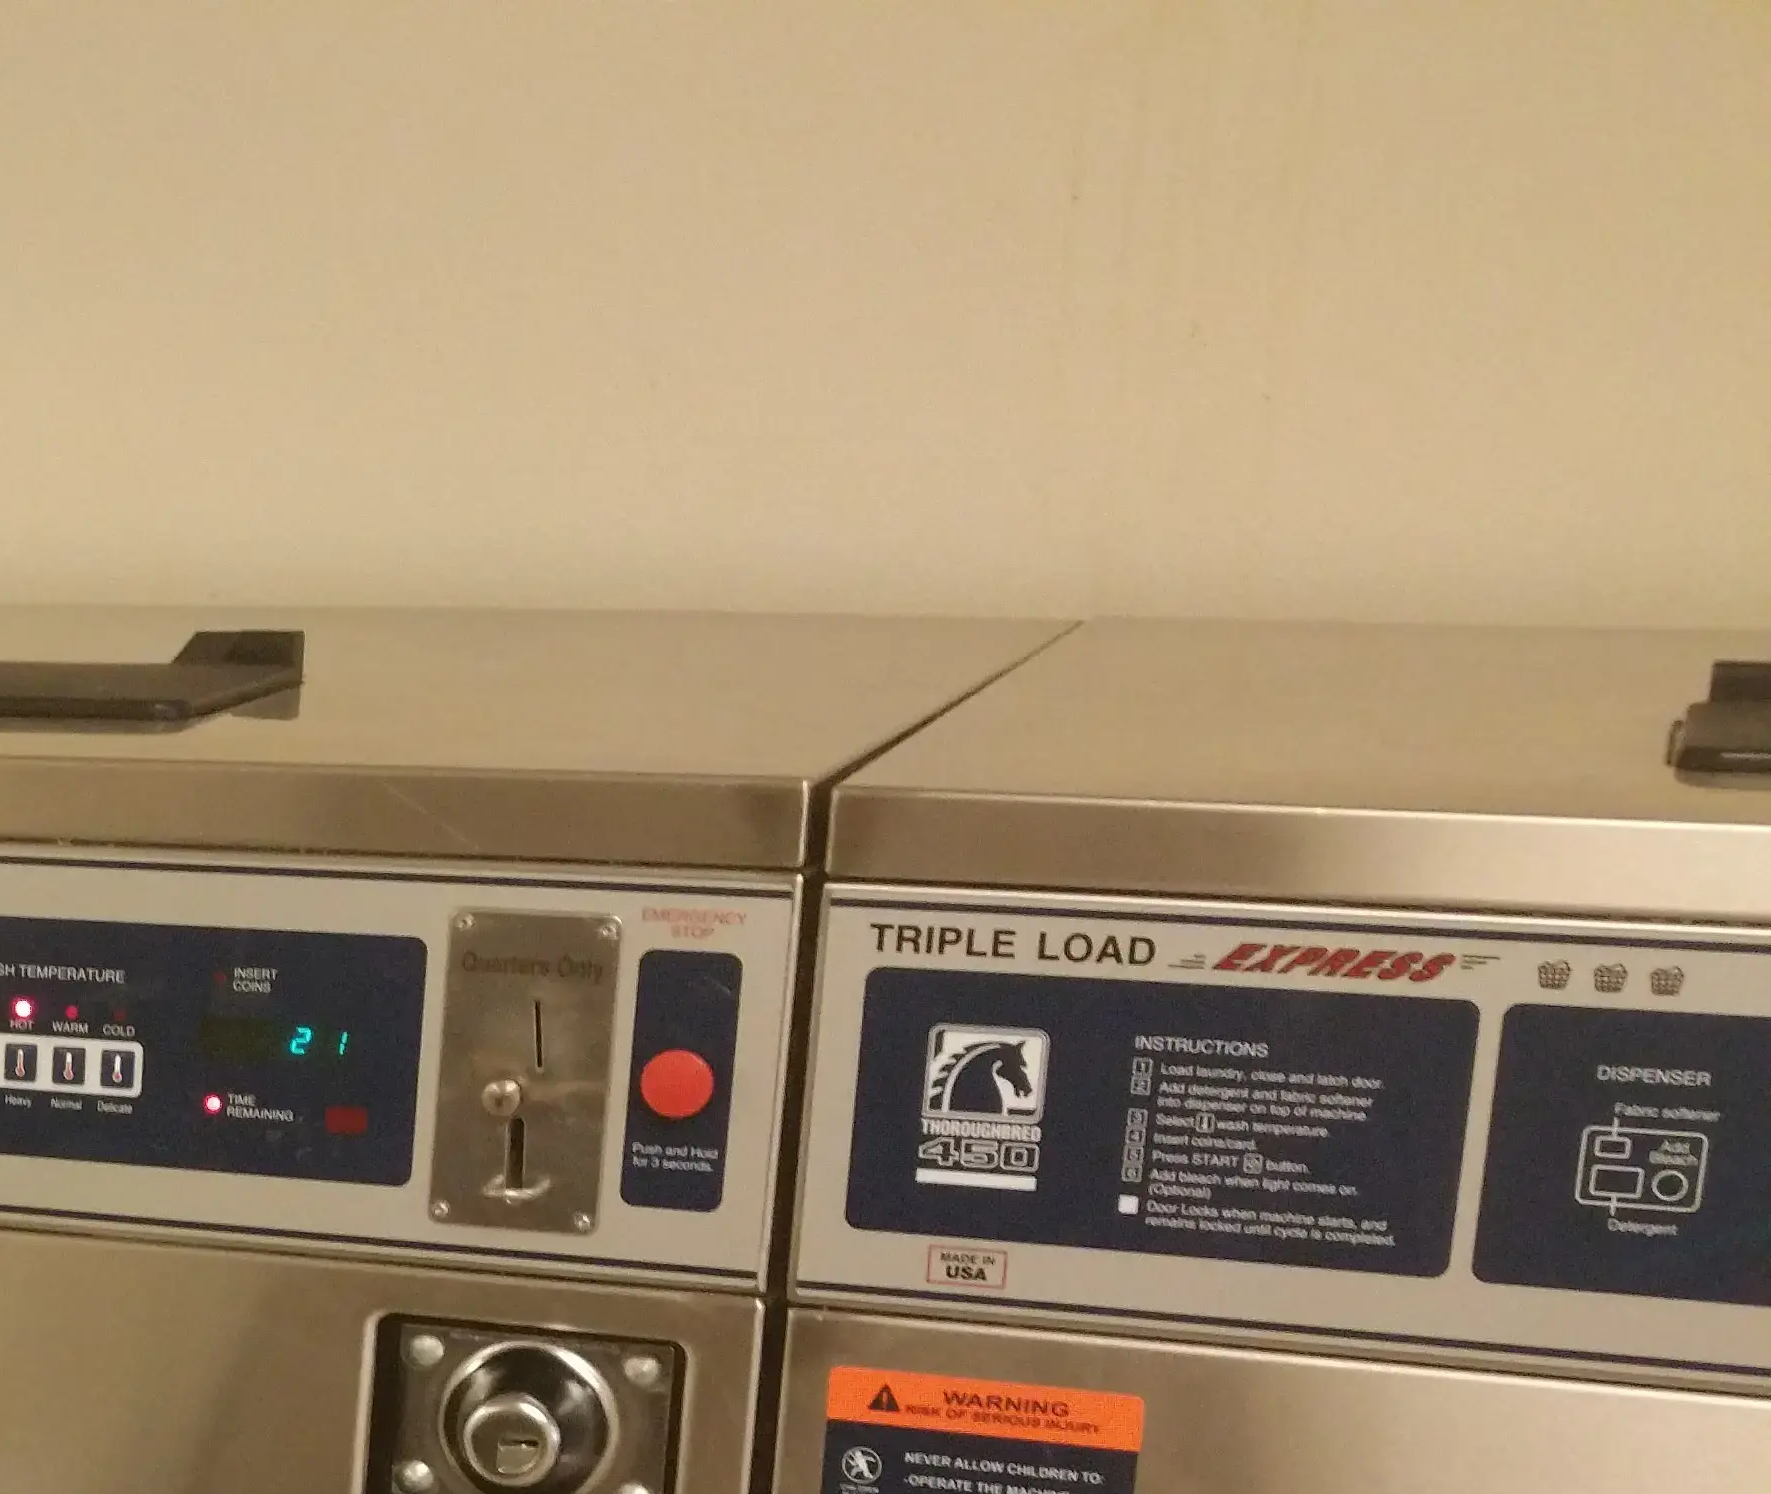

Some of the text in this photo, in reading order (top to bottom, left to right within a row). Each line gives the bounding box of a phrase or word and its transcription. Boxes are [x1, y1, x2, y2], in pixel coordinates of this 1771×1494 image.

[870, 923, 1455, 983] TRIPLE LOAD EXPRESS
[19, 964, 125, 984] TEMPERATURE
[235, 967, 277, 981] INSERT
[461, 951, 604, 983] Quarters Only
[233, 979, 271, 994] COINS
[11, 1018, 34, 1031] HOT
[53, 1022, 88, 1036] WARM
[103, 1023, 135, 1038] COLD
[289, 1027, 348, 1055] 21
[1135, 1035, 1269, 1058] INSTRUCTIONS
[1161, 1061, 1193, 1076] Load
[1288, 1072, 1314, 1084] and
[1317, 1073, 1348, 1086] latch
[1596, 1064, 1712, 1087] DISPENSER
[1159, 1081, 1185, 1095] Add
[1251, 1090, 1277, 1101] and
[5, 1094, 32, 1109] Heavy
[50, 1096, 82, 1111] Normal
[97, 1099, 133, 1115] Delicate
[228, 1094, 256, 1107] TIME
[227, 1105, 293, 1122] REMAINING
[1269, 1104, 1291, 1117] top
[1293, 1105, 1307, 1117] of
[920, 1118, 1042, 1143] THOROUGHBRED
[632, 1142, 718, 1159] Push and Hold
[918, 1136, 1040, 1173] 450
[632, 1155, 648, 1167] for
[651, 1156, 659, 1168] 3
[1191, 1152, 1239, 1168] START
[940, 1252, 995, 1267] MADE IN
[945, 1264, 988, 1282] USA
[943, 1388, 1069, 1418] WARNING
[946, 1408, 967, 1419] OF
[973, 1411, 1040, 1428] SERIOUS
[1043, 1419, 1099, 1434] INJURY
[904, 1451, 952, 1468] NEVER
[953, 1457, 1004, 1475] ALLOW
[1007, 1461, 1079, 1483] CHILDREN
